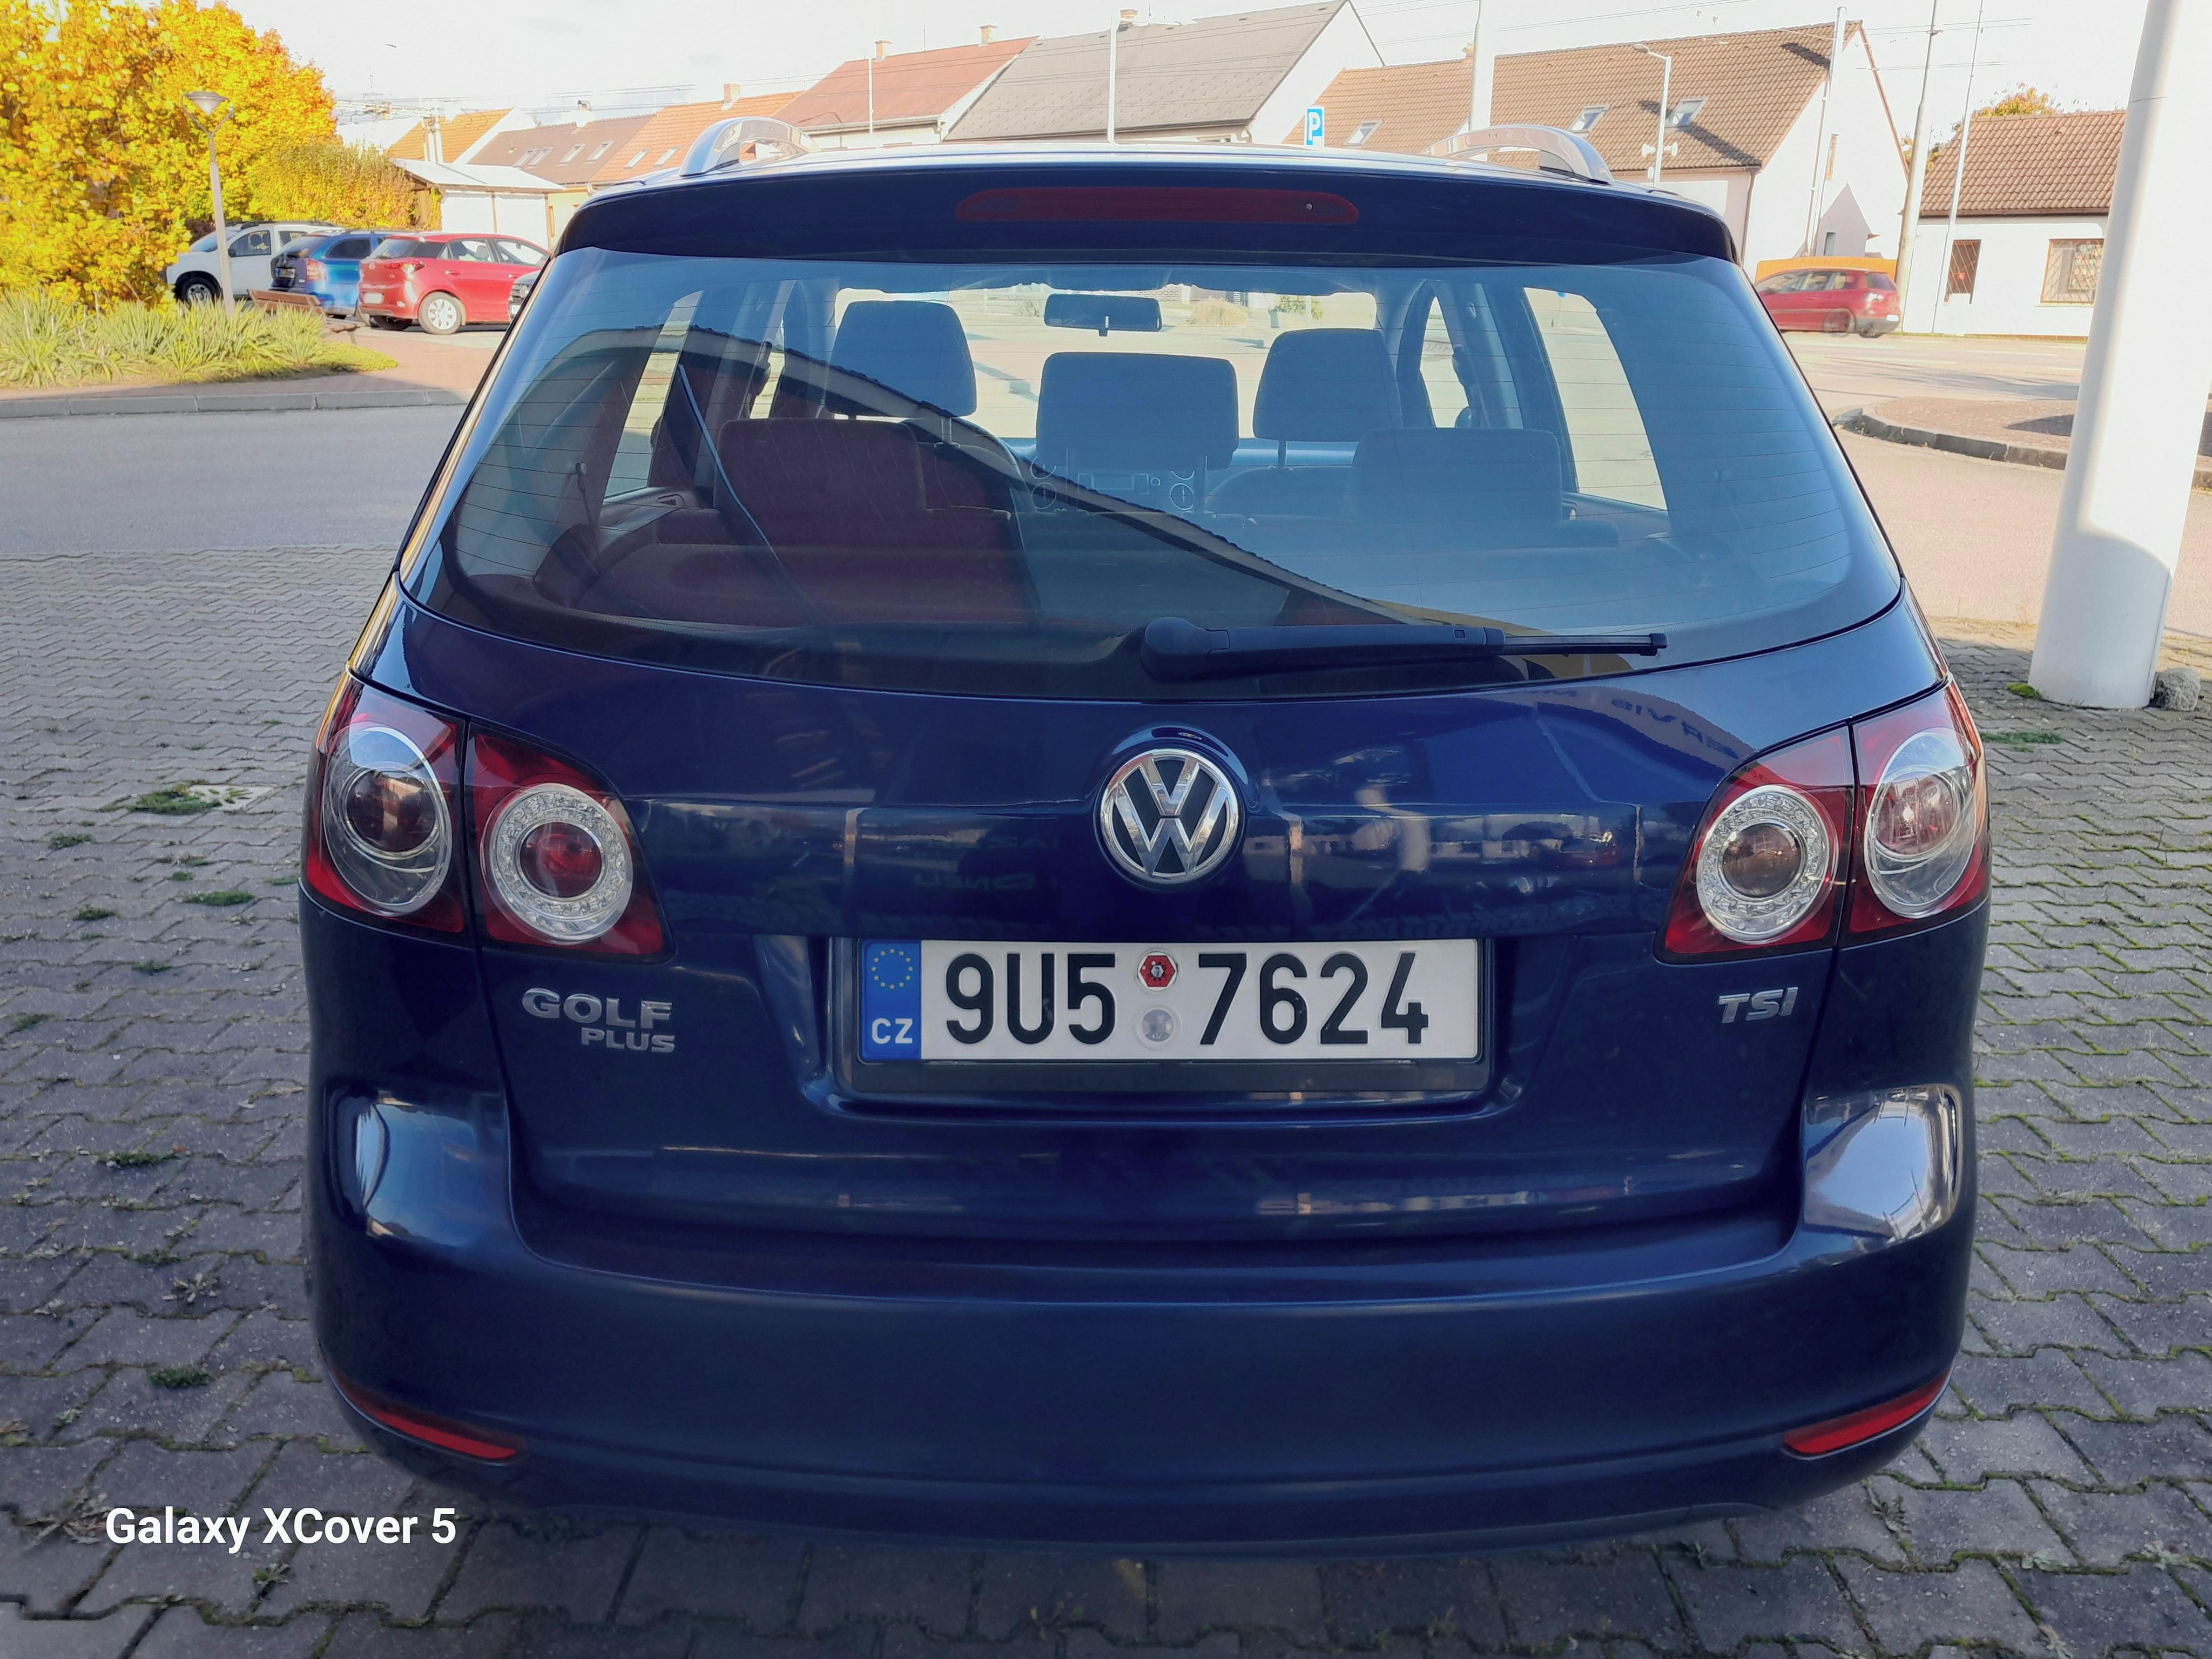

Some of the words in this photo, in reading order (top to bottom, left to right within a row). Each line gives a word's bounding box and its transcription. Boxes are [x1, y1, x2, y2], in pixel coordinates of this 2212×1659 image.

[1308, 112, 1321, 141] P
[522, 987, 673, 1029] GOLF
[945, 953, 1117, 1046] 9U5
[1198, 952, 1429, 1046] 7624
[1718, 987, 1799, 1024] TSI
[581, 1027, 676, 1053] PLUS
[871, 1017, 913, 1045] CZ
